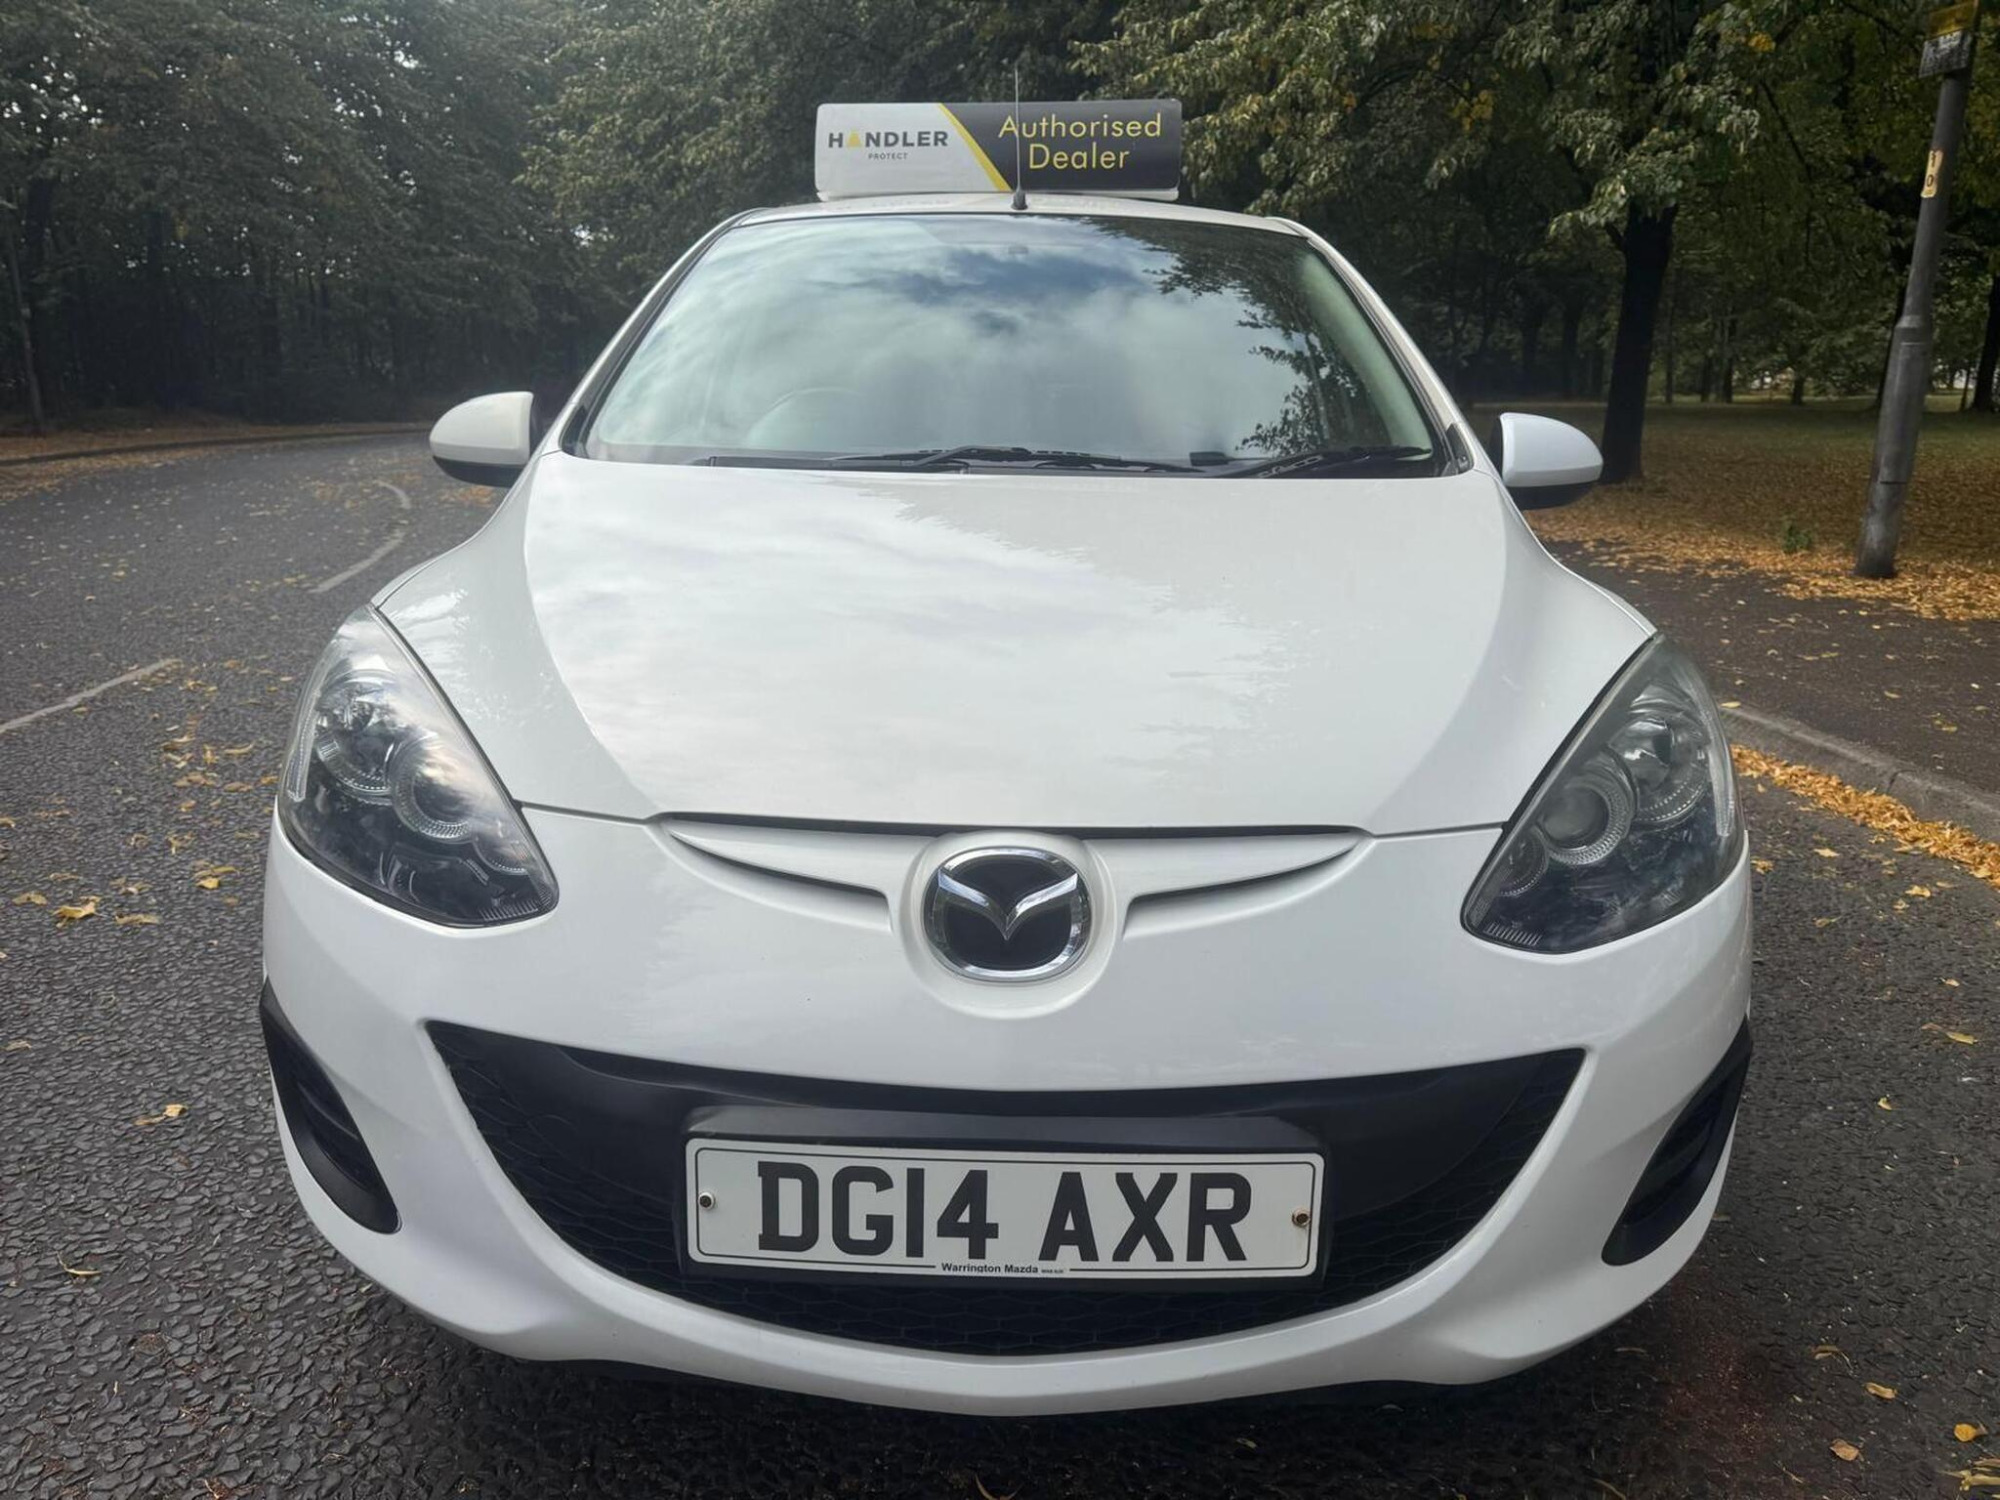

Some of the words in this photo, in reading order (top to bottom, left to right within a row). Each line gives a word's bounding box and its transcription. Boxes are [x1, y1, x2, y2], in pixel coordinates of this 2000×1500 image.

[998, 113, 1162, 139] Authorised
[867, 152, 909, 161] PROTECT
[1028, 143, 1131, 170] Dealer
[757, 1160, 999, 1259] DG14
[1038, 1171, 1252, 1263] AXR
[941, 1262, 1001, 1274] Warrington
[1004, 1264, 1039, 1274] Mazda
